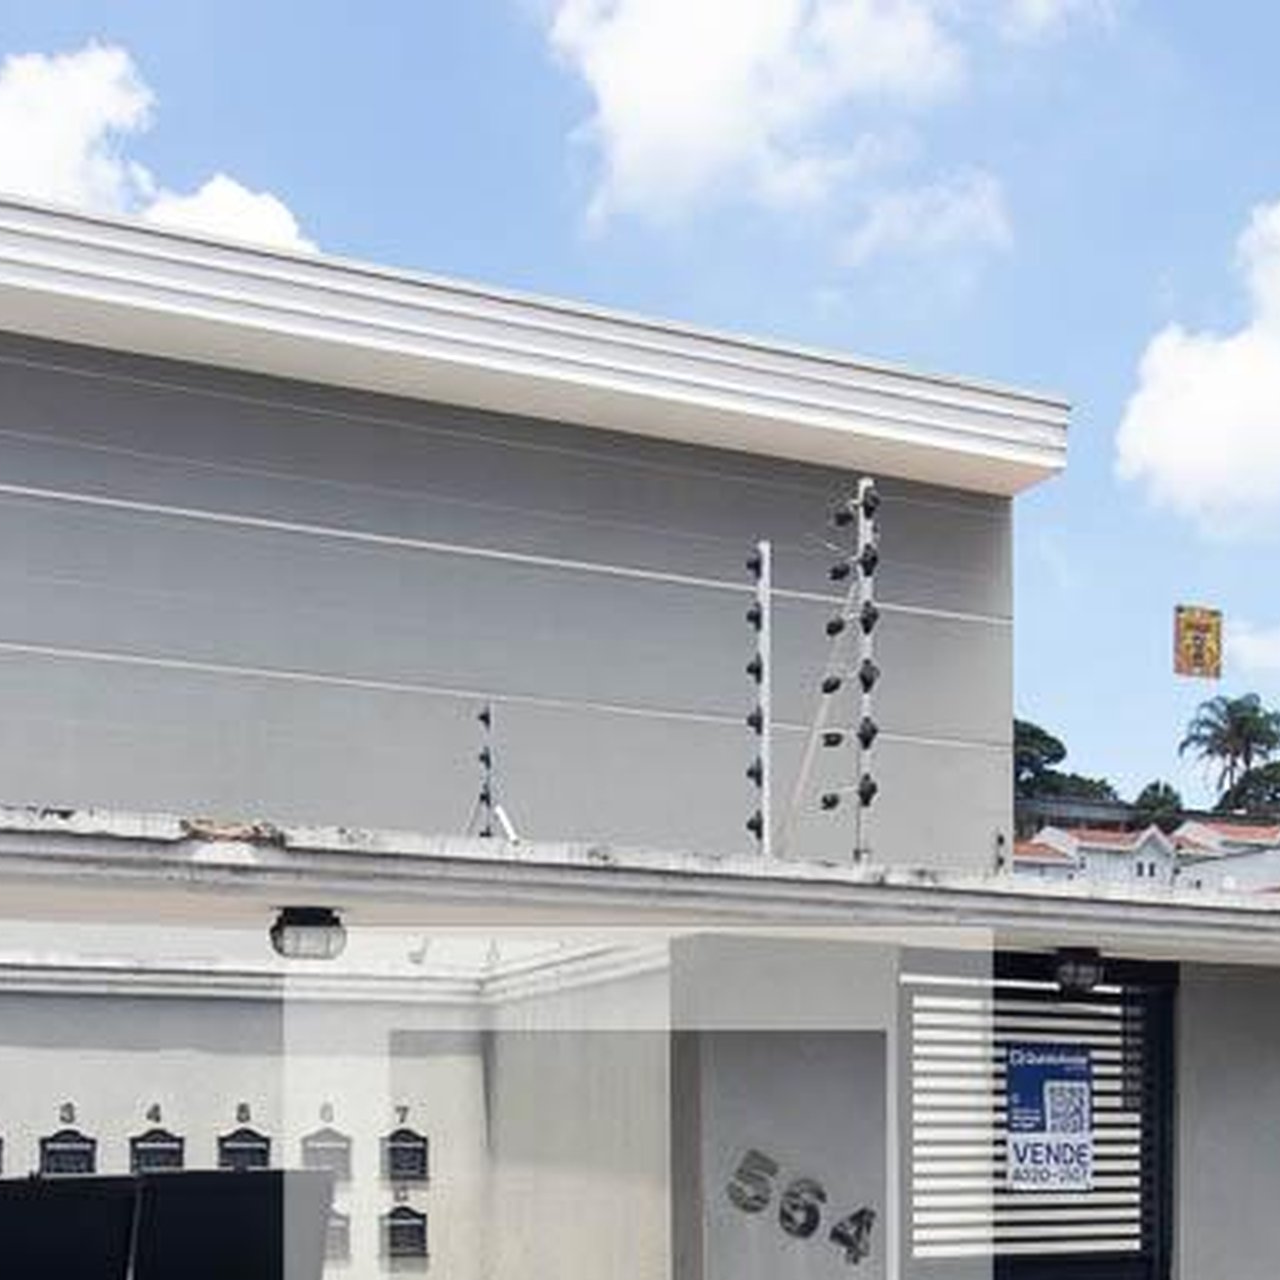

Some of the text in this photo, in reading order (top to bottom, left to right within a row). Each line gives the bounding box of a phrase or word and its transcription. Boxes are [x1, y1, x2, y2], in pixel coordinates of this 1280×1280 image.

[59, 1103, 75, 1123] 3
[146, 1103, 162, 1123] 4
[396, 1107, 410, 1124] 7
[1013, 1142, 1089, 1167] VENDE
